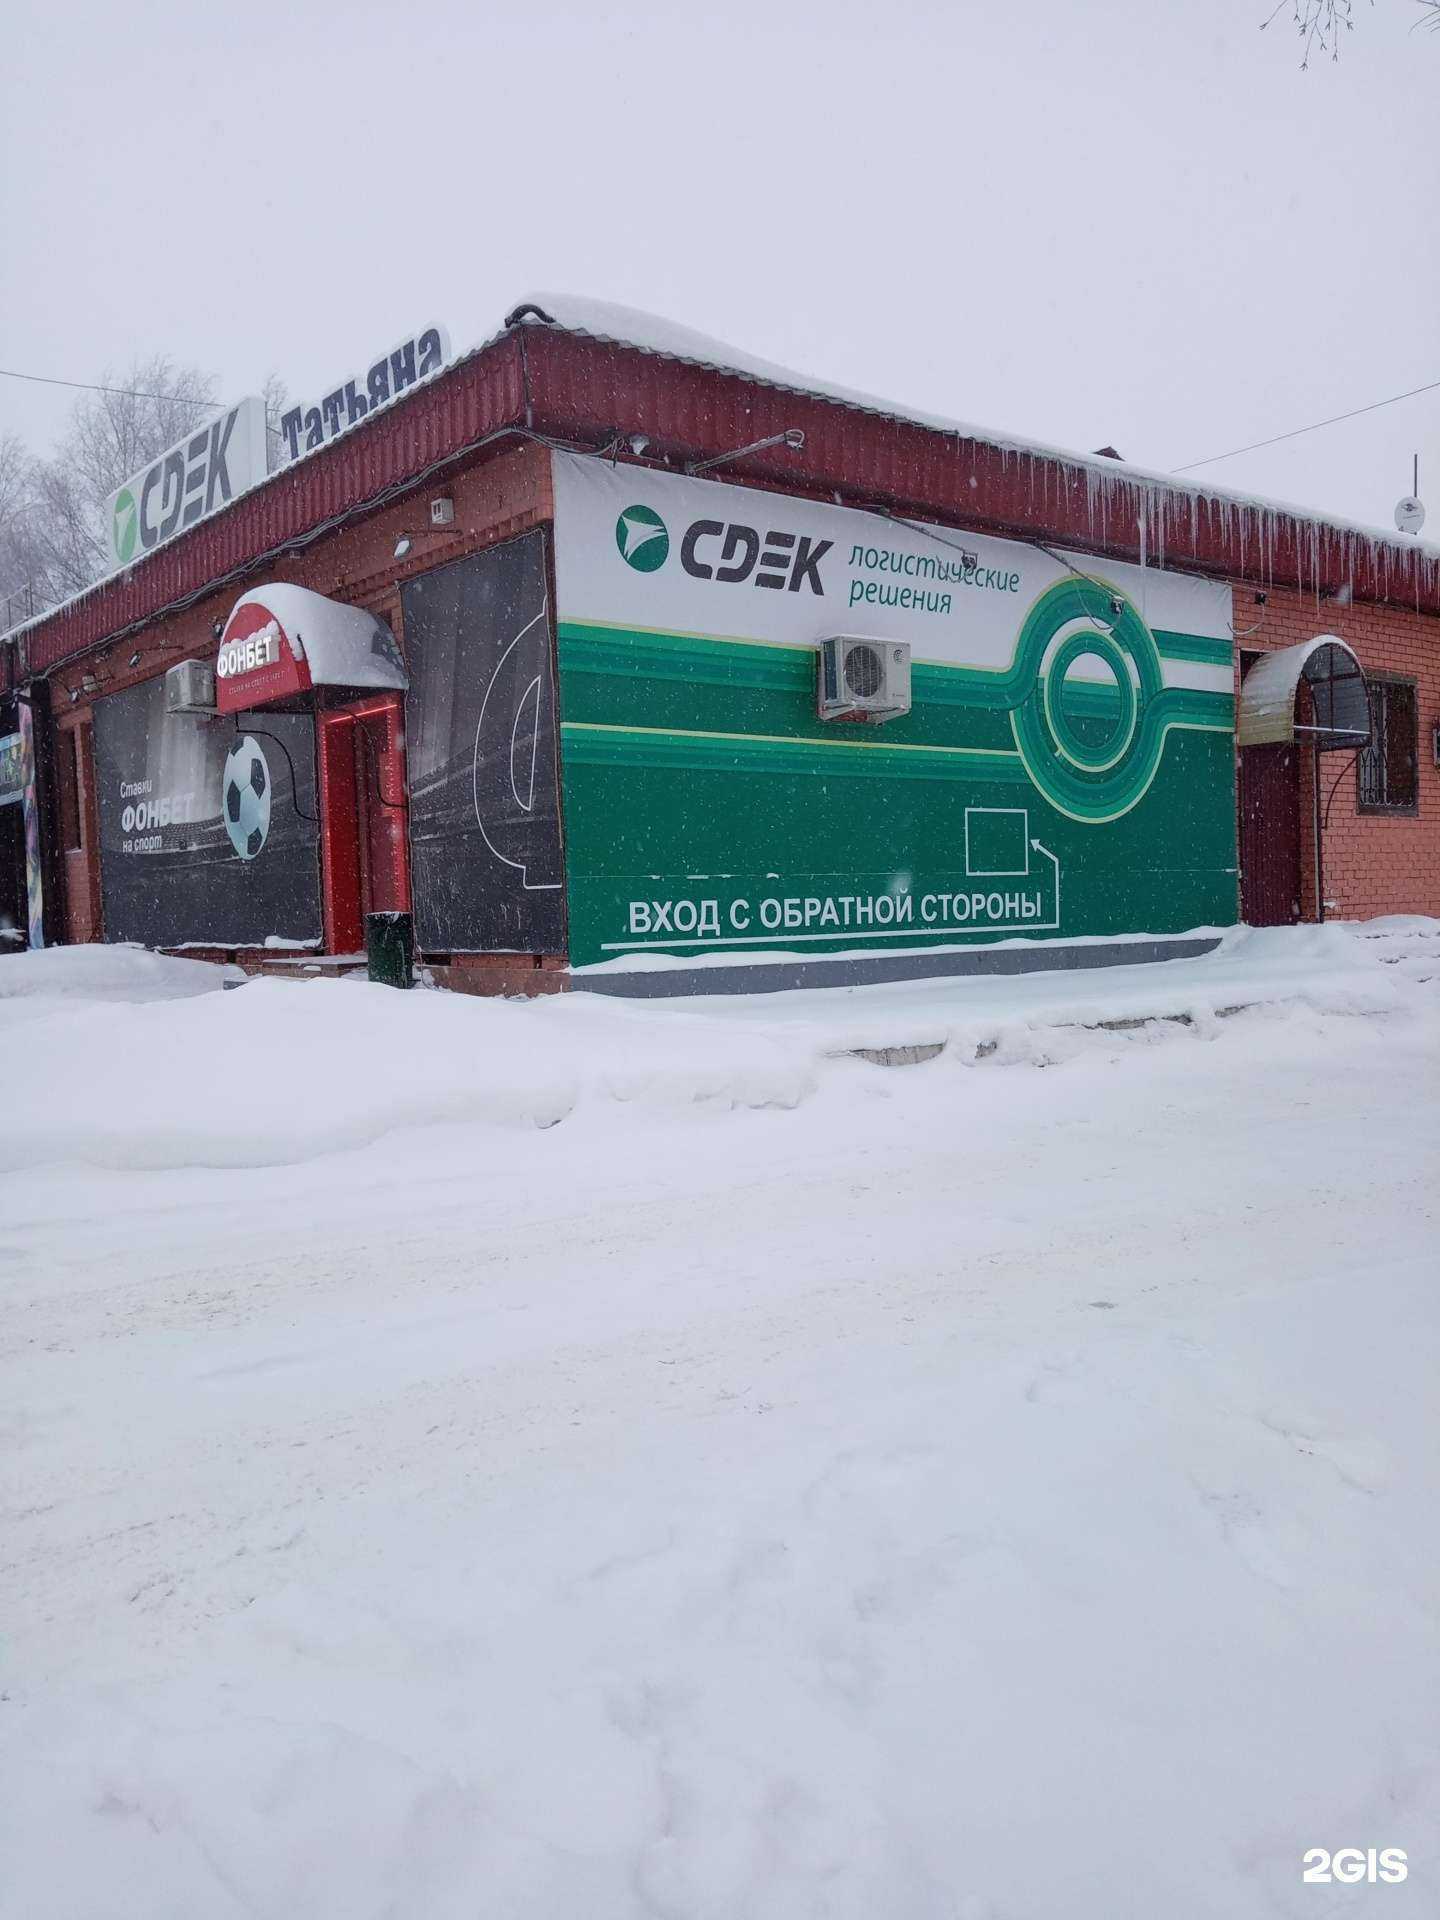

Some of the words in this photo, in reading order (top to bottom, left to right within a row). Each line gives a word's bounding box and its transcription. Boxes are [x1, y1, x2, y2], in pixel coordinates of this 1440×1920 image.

[281, 328, 442, 460] Татьяна
[140, 409, 239, 548] CDEK
[680, 519, 834, 596] CDEK
[848, 545, 1020, 593] логистические
[848, 579, 952, 614] решения
[217, 635, 272, 678] ФОНБЕТ
[120, 780, 152, 799] Ставки
[122, 839, 133, 853] на
[134, 835, 162, 852] спорт
[629, 900, 721, 936] ВХОД
[730, 900, 750, 929] С
[759, 887, 913, 928] ОБРАТНОЙ
[920, 892, 1042, 922] СТОРОНЫ
